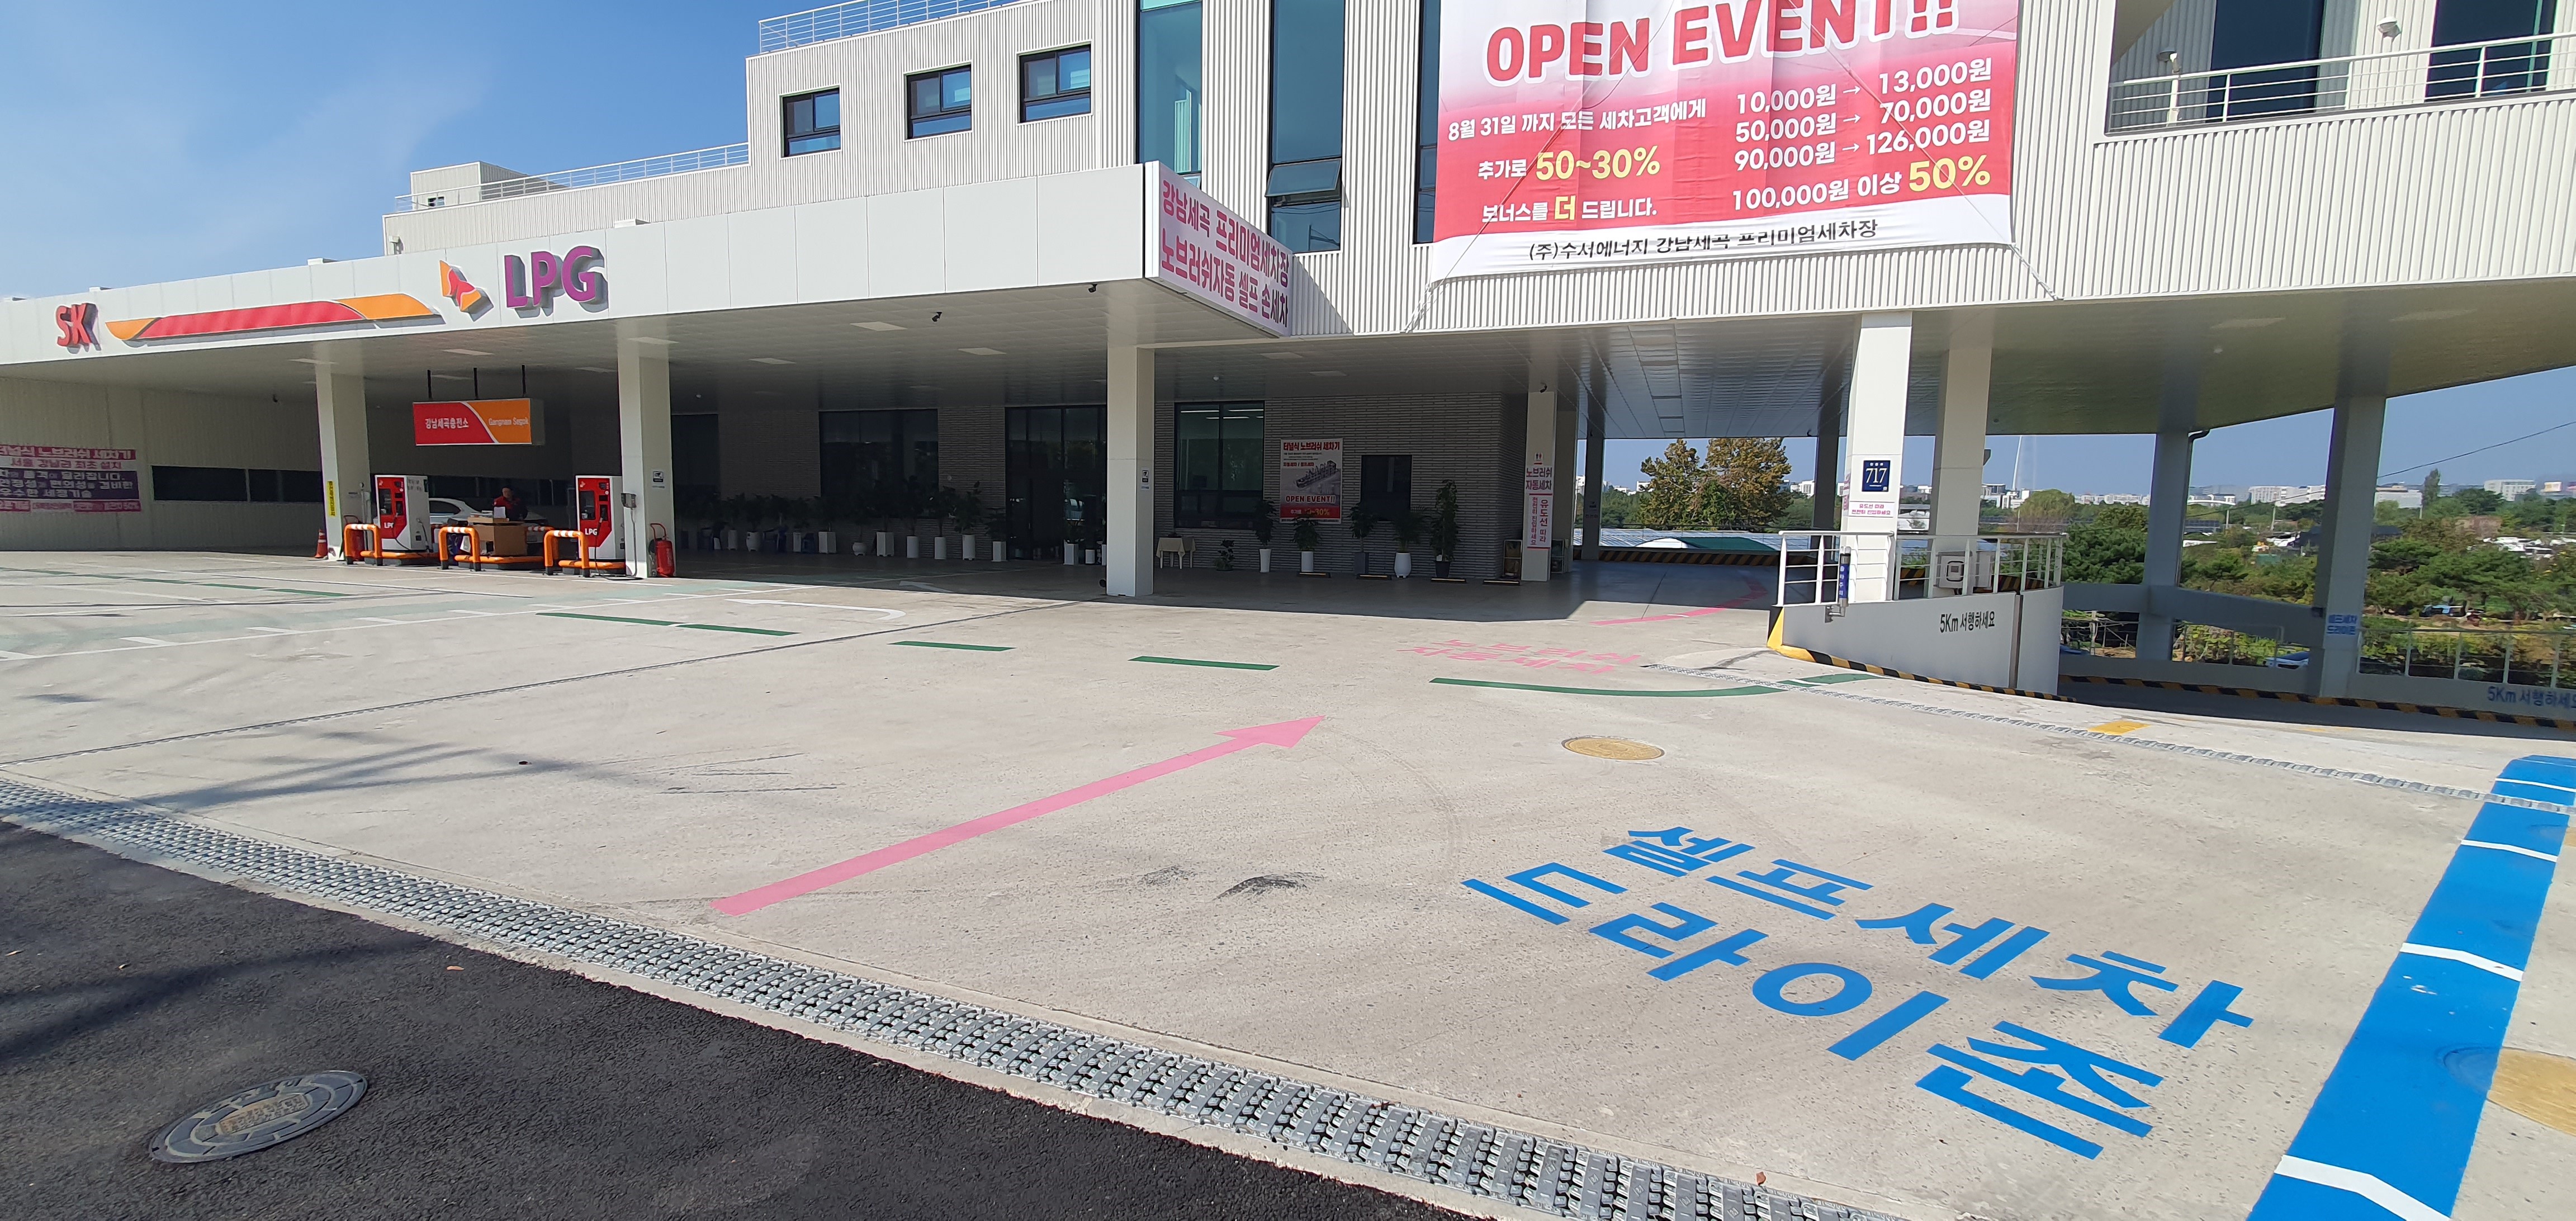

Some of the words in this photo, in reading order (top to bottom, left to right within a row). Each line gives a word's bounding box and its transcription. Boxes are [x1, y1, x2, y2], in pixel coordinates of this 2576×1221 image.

[1487, 18, 1650, 81] OPEN
[1736, 84, 1837, 114] 10,000원
[1879, 57, 1992, 94] 13,000원
[1448, 119, 1475, 141] 8월
[1480, 115, 1516, 136] 31일
[1521, 112, 1555, 132] 까지
[1560, 110, 1594, 131] 모든
[1599, 98, 1706, 131] 세차고객에게
[1735, 112, 1837, 143] 50,000원
[1879, 88, 1991, 124] 70,000원
[1478, 159, 1527, 180] 추가로
[1535, 145, 1661, 181] 50~30%
[1734, 141, 1836, 171] 90,000원
[1866, 119, 1990, 155] 126,000원
[1732, 178, 1849, 211] 100,000원
[1857, 171, 1903, 197] 이상
[1908, 154, 1991, 192] 50%
[1482, 201, 1549, 223] 보너스를
[1554, 196, 1576, 221] 더
[1581, 197, 1658, 220] 드립니다.
[1163, 179, 1210, 238] 강남세곡
[1215, 209, 1290, 288] 프리미엄세차장
[1529, 242, 1649, 261] (주)수서에너지
[1656, 234, 1731, 254] 강남세곡
[1738, 219, 1879, 247] 프리미엄세차장
[504, 245, 596, 308] LPG
[1161, 227, 1235, 302] 노브러쉬자동
[1238, 271, 1258, 314] 셀프
[1261, 283, 1289, 328] 손세차
[56, 302, 92, 347] SK
[39, 447, 91, 459] 노브러쉬
[1283, 442, 1300, 451] 터널식
[1300, 442, 1322, 451] 노브러쉬
[1323, 441, 1340, 451] 세차기
[1526, 467, 1552, 477] 노브러쉬
[1526, 480, 1552, 490] 자동세차
[1865, 467, 1887, 484] 717
[1540, 499, 1549, 527] 유도선
[1940, 613, 1958, 633] 5Km
[1960, 610, 1995, 631] 서행하세요
[2488, 685, 2516, 703] 5Km
[1460, 860, 2165, 1160] 드라이존
